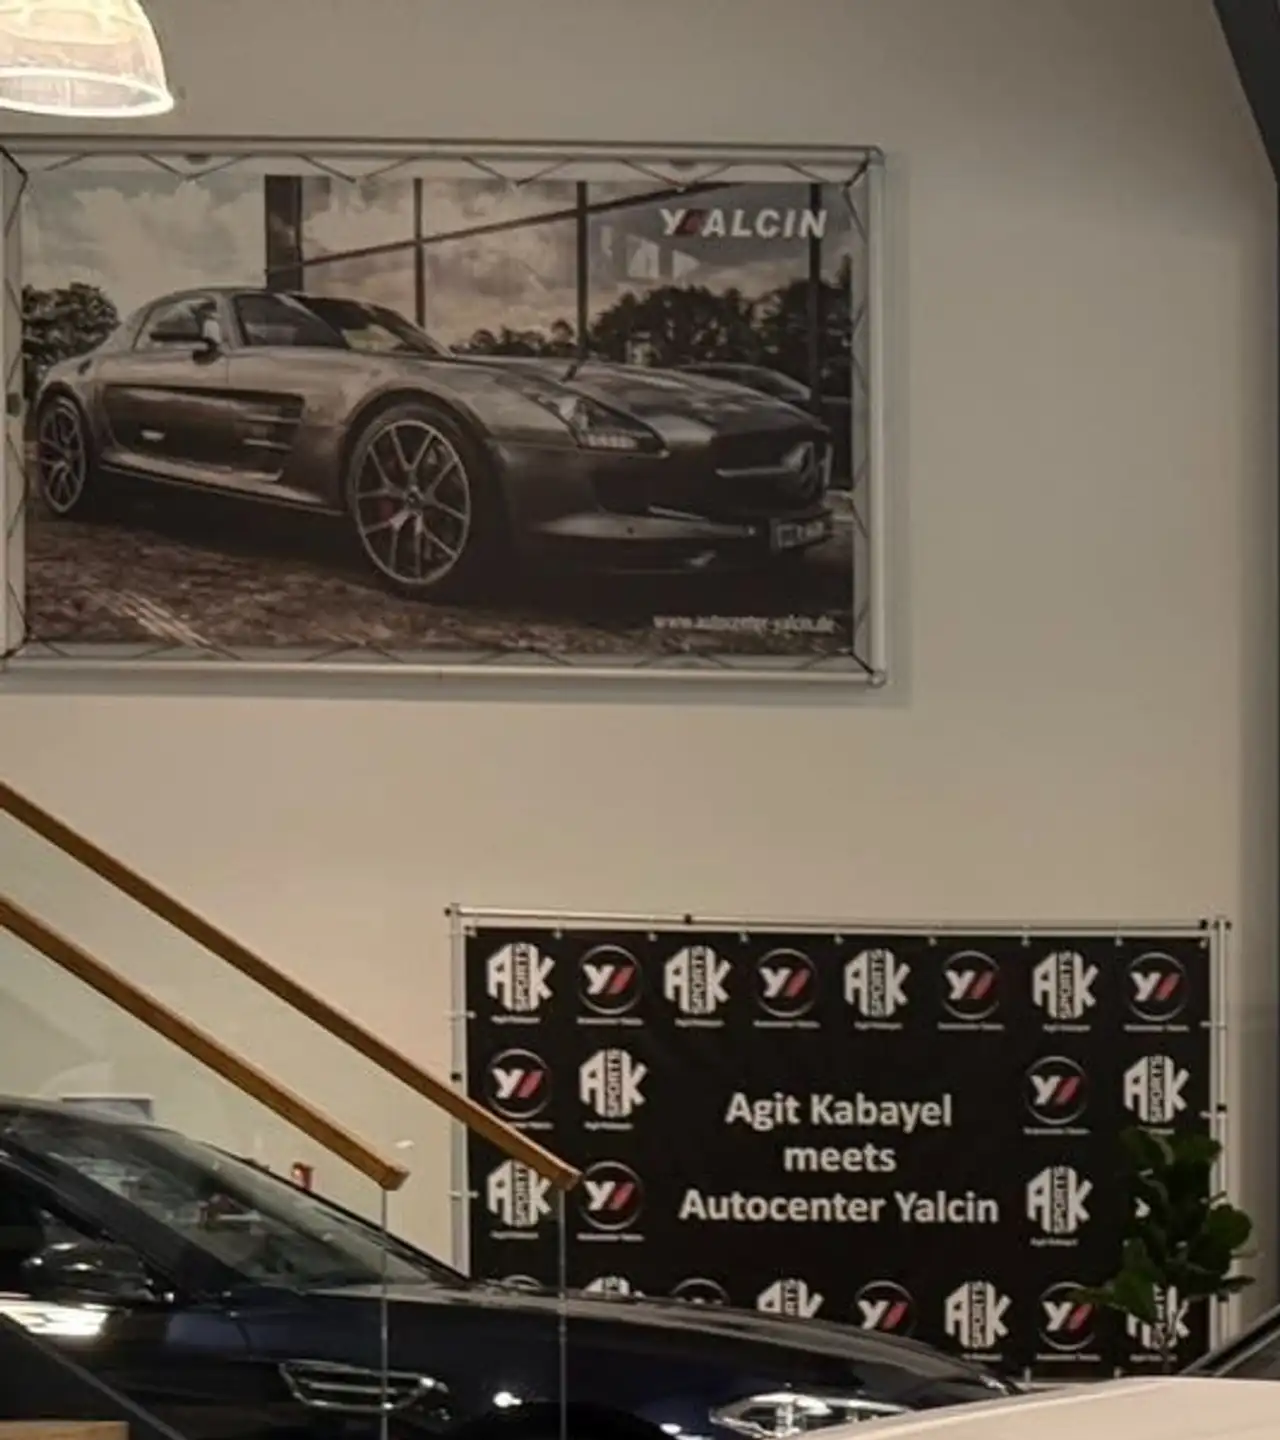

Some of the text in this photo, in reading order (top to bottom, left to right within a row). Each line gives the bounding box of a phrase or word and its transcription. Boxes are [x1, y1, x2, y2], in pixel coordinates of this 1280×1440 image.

[659, 208, 828, 239] YALCIN
[725, 1092, 952, 1133] Agit Kabayel
[784, 1143, 896, 1172] meets
[679, 1189, 998, 1223] Autocenter Yalcin
